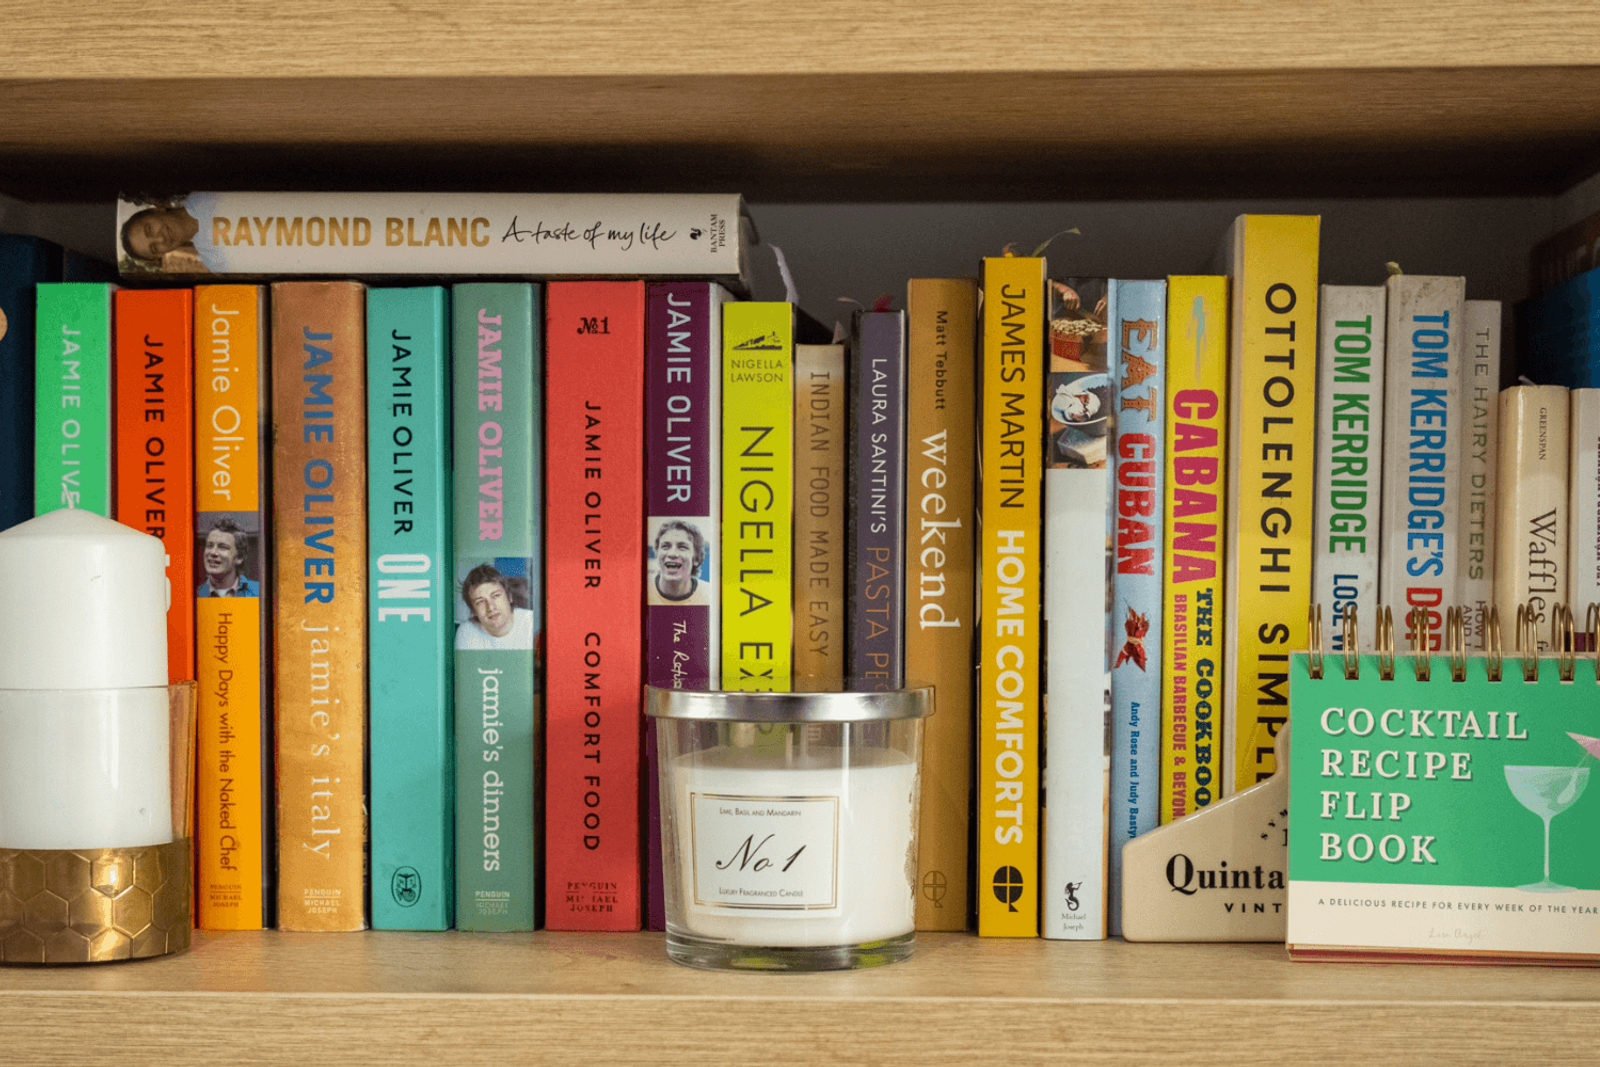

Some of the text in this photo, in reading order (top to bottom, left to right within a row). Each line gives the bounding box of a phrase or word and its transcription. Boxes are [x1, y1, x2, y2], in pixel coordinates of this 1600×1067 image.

[212, 216, 491, 248] RAYMOND BLANC
[502, 215, 677, 250] A taste of my life
[710, 214, 718, 253] BANTAM
[718, 219, 726, 247] PRESS
[61, 324, 81, 409] JAMIE
[144, 334, 165, 422] JAMIE
[731, 359, 783, 370] NIGELLA
[731, 372, 783, 383] LAWSON
[934, 310, 949, 410] Matt Tebbutt
[1333, 315, 1372, 383] TOM
[1411, 310, 1450, 378] TOM
[212, 303, 245, 501] Jamie Oliver
[391, 329, 413, 535] JAMIE OLIVER
[478, 308, 503, 541] JAMIE OLIVER
[666, 293, 692, 502] JAMIE OLIVER
[871, 358, 888, 425] LAURA
[1538, 407, 1547, 461] GREENSPAN
[303, 326, 335, 605] JAMIE OLIVER
[1117, 318, 1158, 576] EAT CUBAN
[1260, 283, 1297, 592] OTTOLENGHI
[1329, 394, 1370, 553] KERRIDGE
[1468, 328, 1490, 581] THE HAIRY DIETERS
[584, 401, 601, 589] JAMIE OLIVER
[739, 426, 775, 617] NIGELLA
[809, 372, 830, 657] INDIAN FOOD MADE EASY
[870, 433, 887, 533] SANTINI'S
[1172, 389, 1219, 584] CABANA
[1405, 389, 1448, 577] KERRIDGE'S
[919, 428, 962, 631] weekend
[994, 283, 1026, 845] JAMES MARTIN HOME COMFORTS
[1528, 506, 1558, 623] Waffles
[377, 554, 431, 622] ONE
[865, 547, 890, 640] PASTA
[1462, 605, 1473, 637] AND
[1474, 600, 1486, 637] HOW
[672, 620, 688, 643] The
[739, 642, 774, 691] EX
[213, 613, 238, 871] Happy Days with the Naked Chef
[301, 619, 341, 859] jamie's italy
[583, 632, 601, 851] COMFORT FOOD
[1128, 702, 1141, 727] Andy
[1172, 594, 1188, 820] BRASILIAN BARBECUE & BEYON
[1194, 588, 1215, 811] THE COOKBOO
[1320, 707, 1529, 740] COCKTAIL
[477, 668, 504, 872] jamie's dinners
[1129, 759, 1140, 778] and
[1130, 731, 1140, 755] Rose
[1320, 749, 1472, 781] RECIPE
[1128, 781, 1140, 804] Judy
[1320, 790, 1412, 821] FLIP
[715, 834, 807, 873] No 1
[1319, 832, 1438, 865] BOOK
[570, 904, 613, 912] JOSEPH
[1062, 922, 1085, 932] Joseph
[1329, 898, 1387, 907] DELICIOUS
[1391, 900, 1428, 909] RECIPE
[1432, 902, 1453, 910] FOR
[1458, 902, 1490, 911] EVERY
[1495, 903, 1524, 912] WEEK
[1529, 904, 1543, 913] OF
[1547, 905, 1567, 913] THE
[1571, 906, 1599, 915] YEAR
